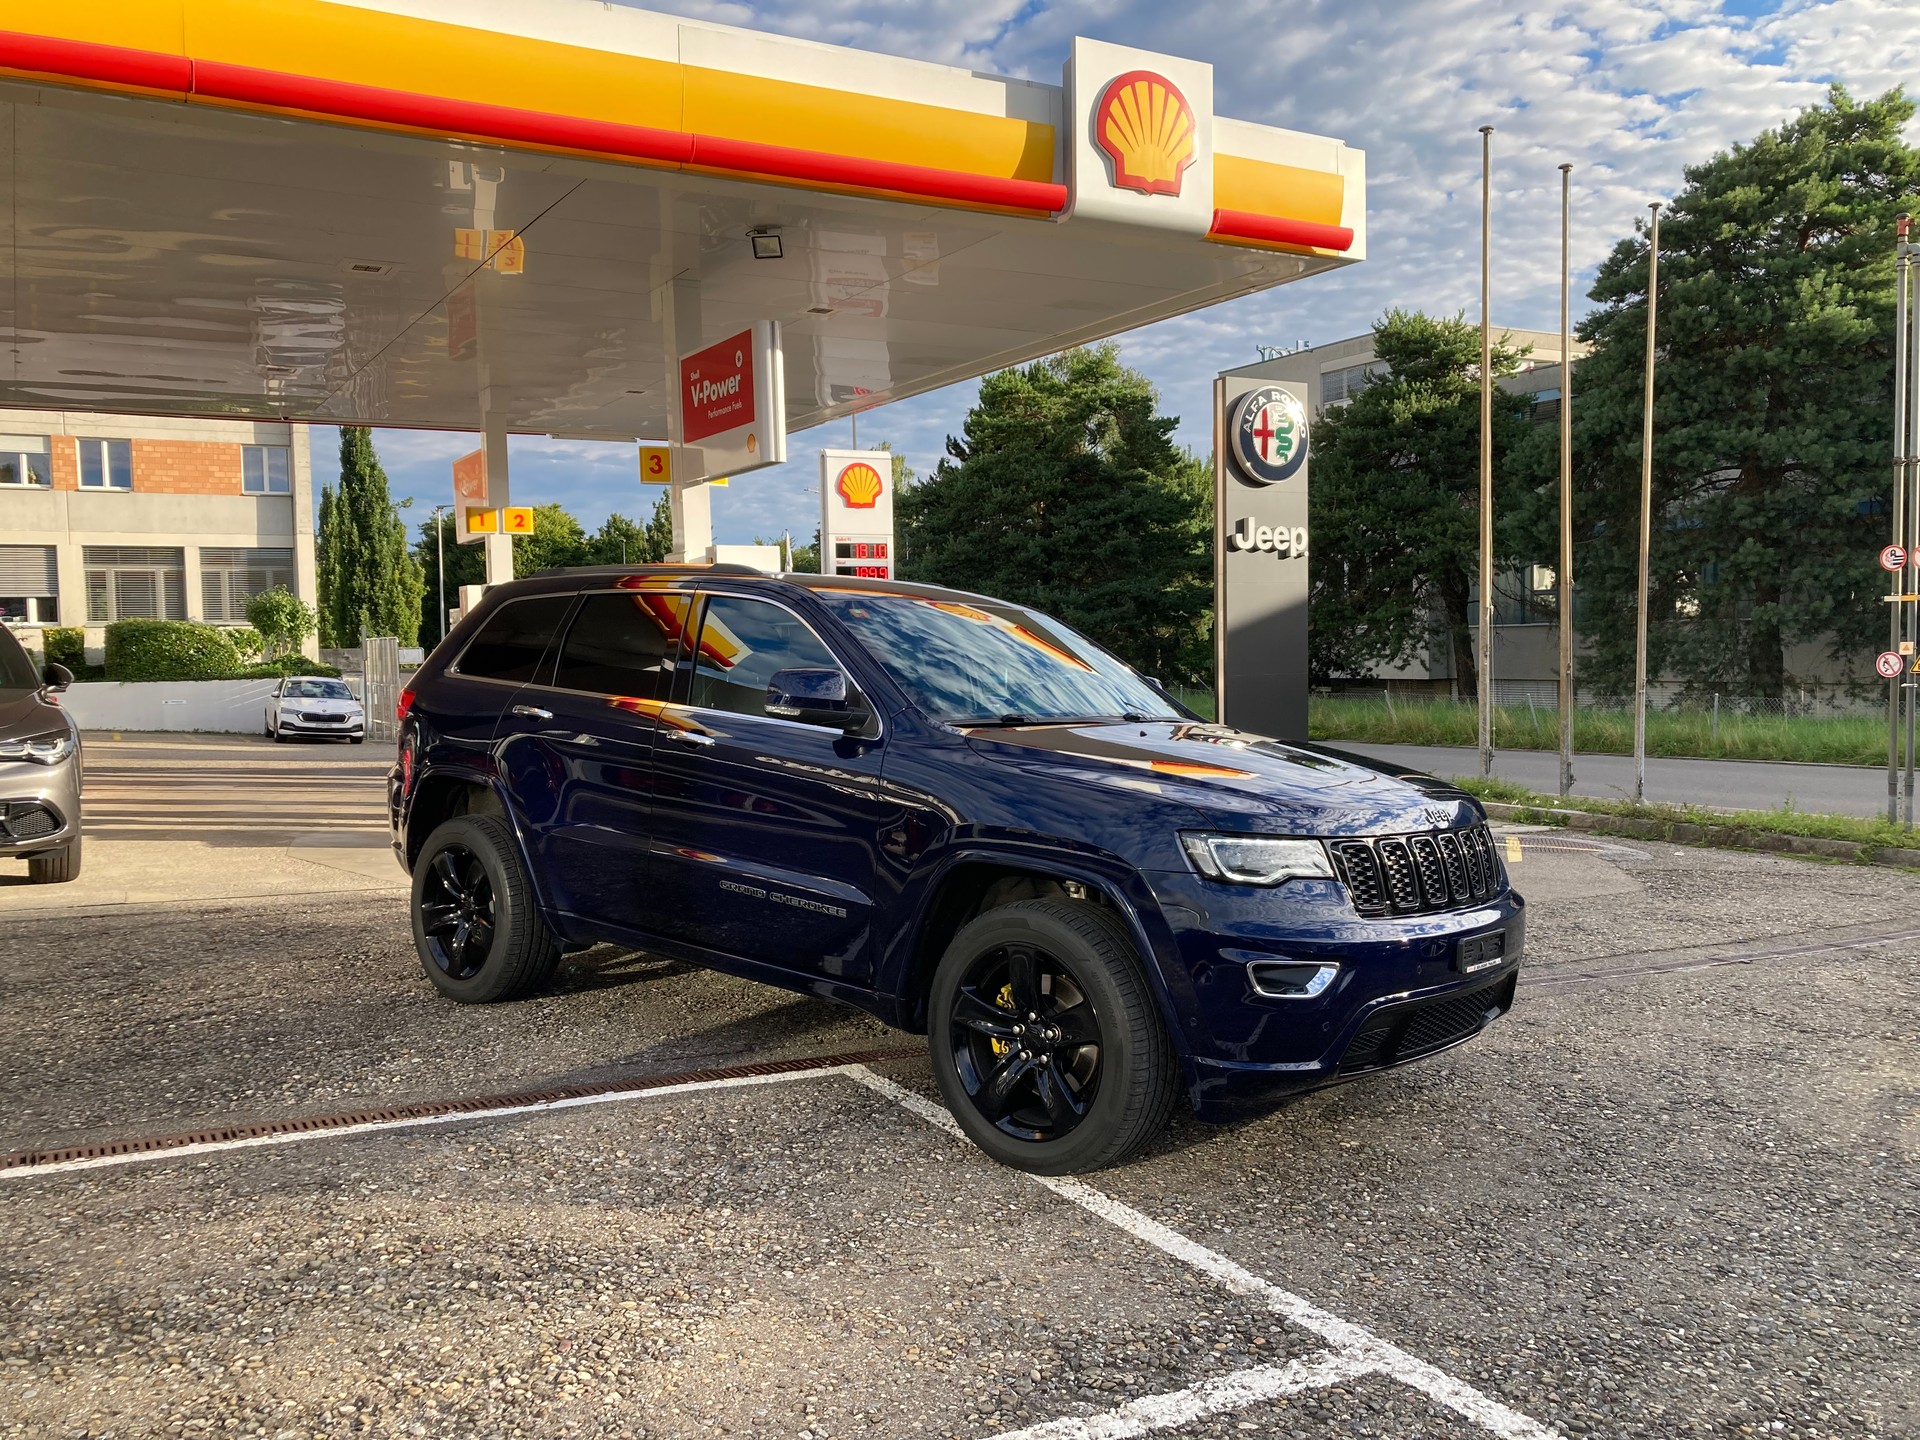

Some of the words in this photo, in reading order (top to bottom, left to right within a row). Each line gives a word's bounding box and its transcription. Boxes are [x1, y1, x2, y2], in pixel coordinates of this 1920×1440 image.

[690, 369, 700, 381] Shell
[690, 373, 741, 408] V-Power
[707, 407, 732, 419] Performance
[1243, 395, 1267, 434] ALFA
[649, 454, 664, 474] 3
[478, 513, 485, 527] 1
[513, 514, 525, 528] 2
[1235, 516, 1309, 557] Jeep
[1424, 807, 1453, 826] Jeep
[720, 880, 767, 899] GRAND
[769, 891, 847, 919] CHEROKEE
